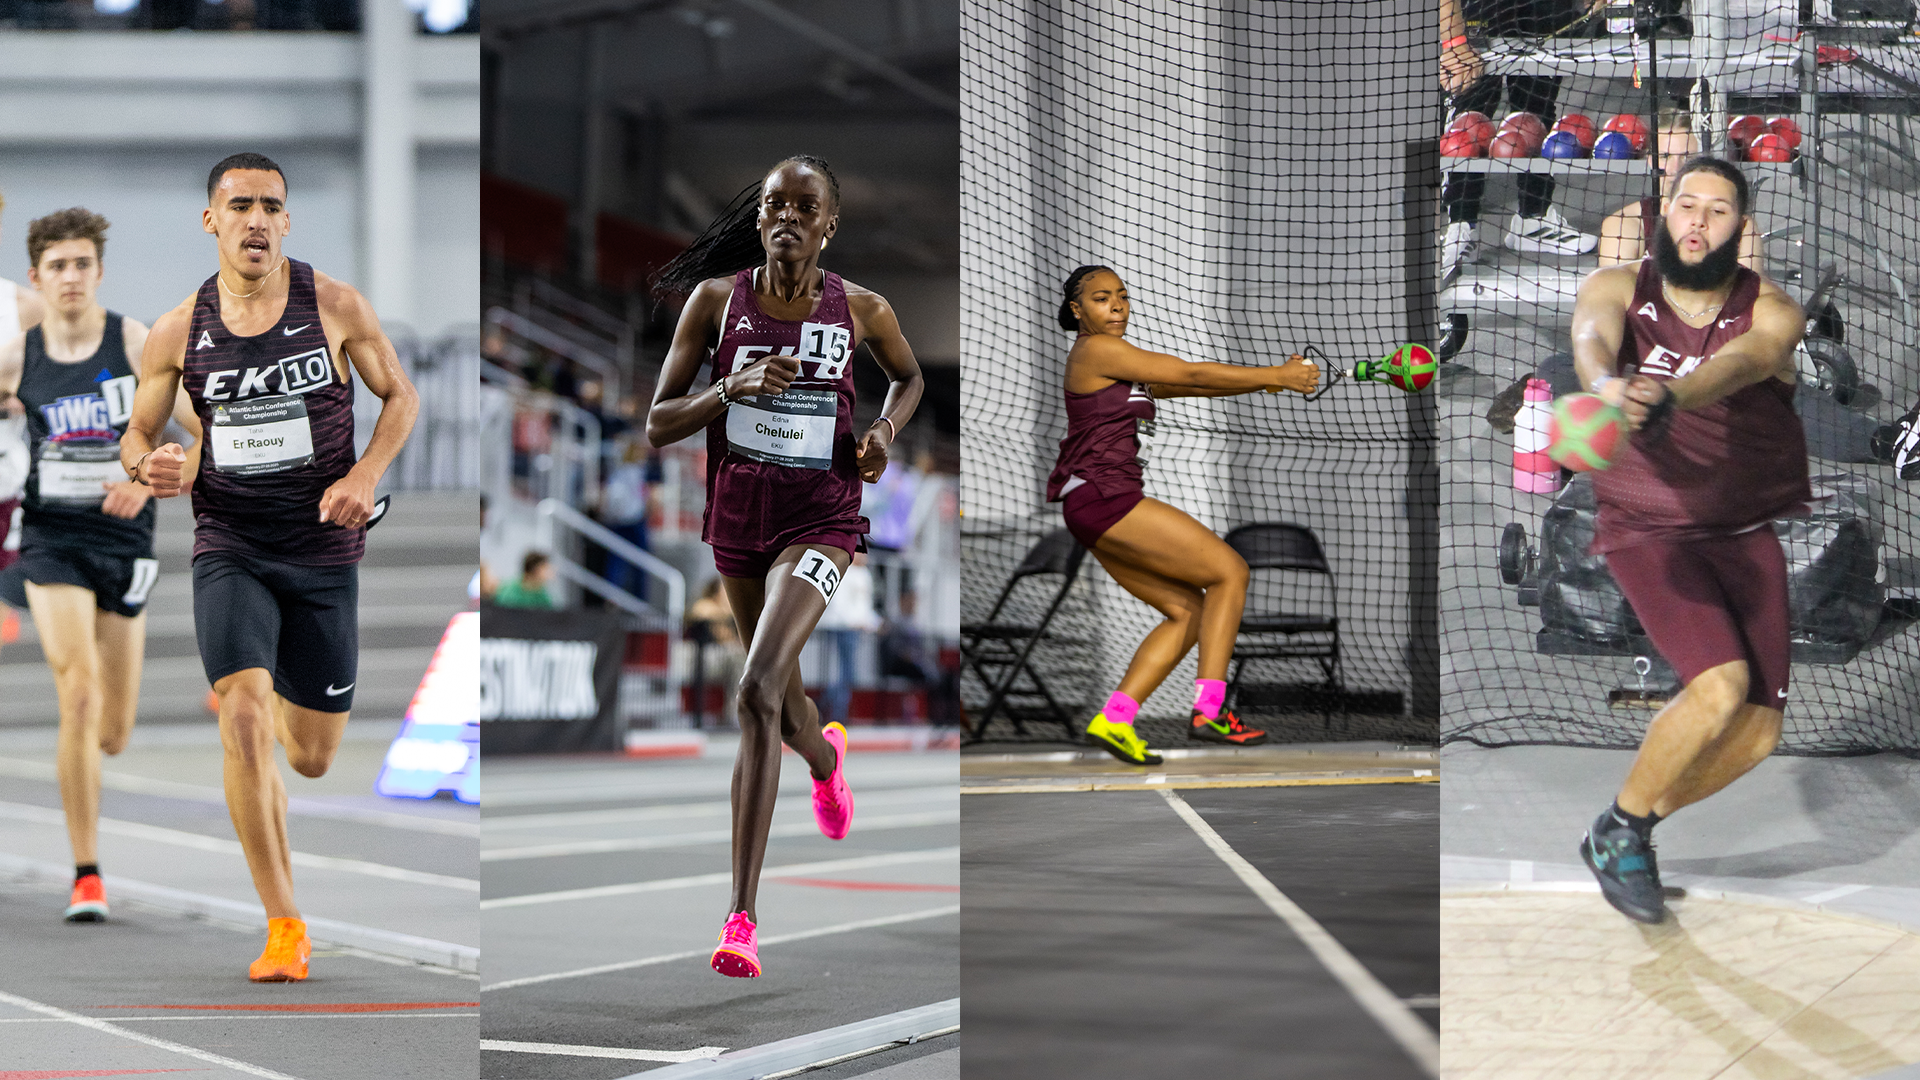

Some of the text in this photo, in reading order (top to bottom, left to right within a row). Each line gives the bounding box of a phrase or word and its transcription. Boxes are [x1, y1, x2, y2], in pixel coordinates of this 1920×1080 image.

[809, 330, 847, 363] 15
[288, 357, 325, 388] 10
[203, 364, 288, 400] EK
[229, 405, 252, 413] Atlantic
[265, 399, 302, 410] Conference
[772, 400, 818, 410] Championship
[798, 394, 834, 403] Conference
[46, 396, 109, 435] UWG
[243, 409, 288, 420] Championship
[772, 415, 789, 424] Edna
[755, 422, 804, 440] Chelulei
[233, 436, 284, 449] Er Raouy
[802, 557, 838, 597] 15
